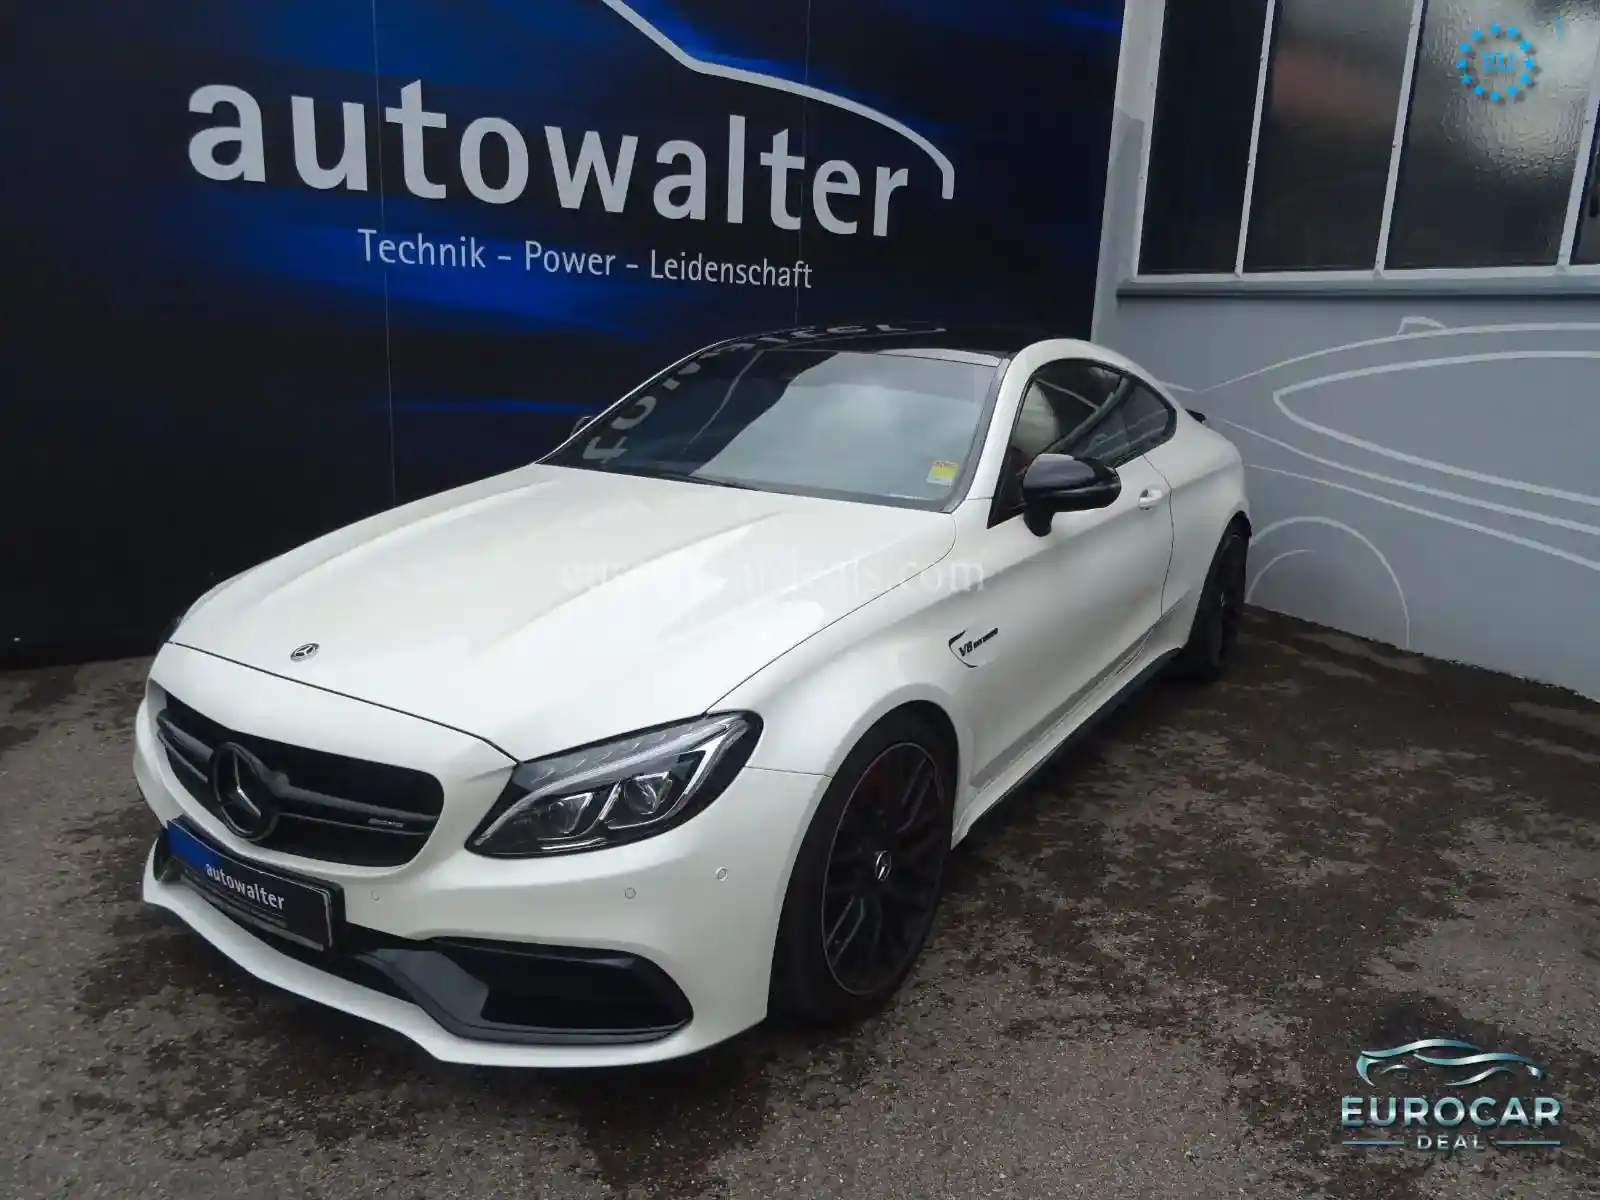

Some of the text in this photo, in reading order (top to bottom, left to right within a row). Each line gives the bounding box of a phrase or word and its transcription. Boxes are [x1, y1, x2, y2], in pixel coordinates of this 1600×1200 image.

[188, 79, 909, 237] autowalter
[357, 228, 486, 268] Technik
[525, 240, 616, 277] Power
[651, 249, 813, 290] Leidenschaft
[204, 862, 285, 910] autowalter
